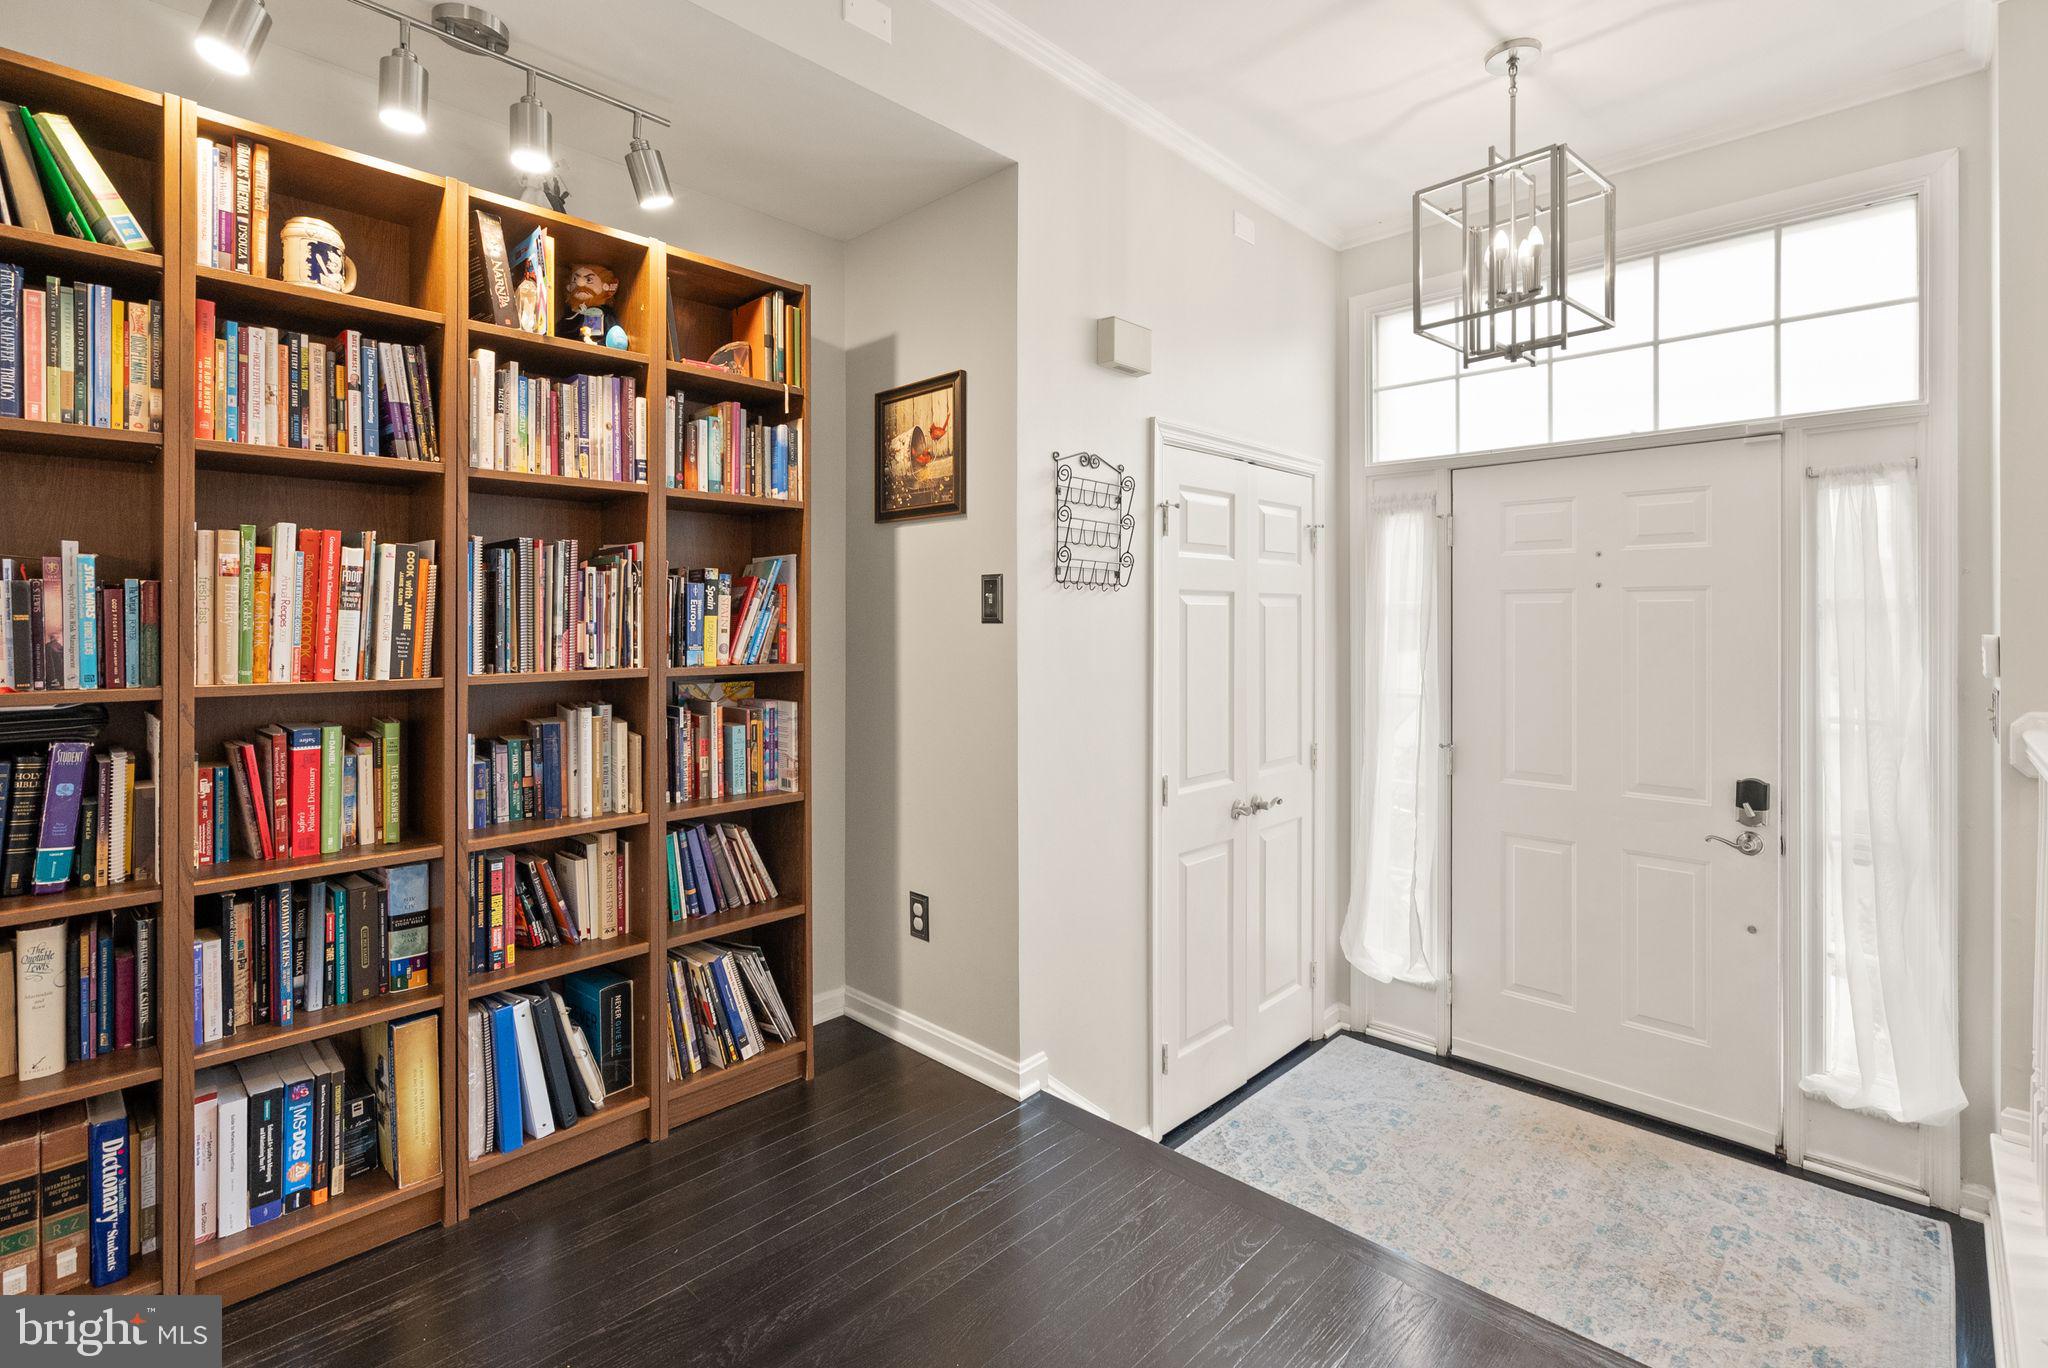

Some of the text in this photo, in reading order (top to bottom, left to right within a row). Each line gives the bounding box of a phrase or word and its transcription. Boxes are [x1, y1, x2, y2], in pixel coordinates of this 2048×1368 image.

[236, 143, 250, 259] OBAMA'S AMERICA D'SOUZA
[491, 259, 510, 308] NARNIA
[0, 270, 16, 402] FRANCIS SCHAEFFER TRILOGY
[152, 359, 160, 381] GOSPEL
[304, 554, 314, 570] Betty
[328, 536, 336, 564] Gooseberry
[406, 550, 416, 578] COOK
[68, 584, 76, 600] Supply
[84, 564, 96, 619] STAR WARS
[198, 576, 210, 624] fresh fast
[243, 566, 252, 632] Christmas Cookbook
[405, 580, 414, 599] with
[706, 584, 716, 610] Spain
[220, 583, 238, 625] Holiday
[278, 599, 290, 628] Recipes
[402, 601, 412, 630] JAMIE
[689, 599, 698, 632] Europe
[720, 596, 729, 628] SPAIN
[128, 620, 136, 640] FOSTER
[254, 591, 268, 648] Cookbook
[301, 600, 314, 658] COOKBOOK
[324, 615, 332, 634] through
[382, 614, 391, 642] FLAVOR
[68, 634, 76, 668] Management
[324, 636, 332, 644] the
[56, 750, 84, 763] STUDENT
[328, 740, 336, 766] DANIEL
[15, 772, 41, 780] HOLY
[392, 782, 398, 790] IQ
[308, 767, 318, 832] Political Dictionary
[298, 812, 310, 833] Safire's
[606, 863, 614, 893] HISTORY
[281, 888, 290, 968] UNCOMMON CURES
[297, 908, 305, 932] YOUNG
[21, 950, 54, 965] Quotable
[30, 945, 45, 955] The
[140, 929, 148, 990] THE CHRISTIAN
[26, 963, 50, 973] Lewis
[296, 952, 304, 976] SHACK
[614, 995, 622, 1018] NEVER
[258, 1134, 266, 1158] Maintaining
[292, 1108, 307, 1160] MS-DOS
[295, 1165, 306, 1177] 20
[48, 1182, 81, 1196] DICTIONARY
[64, 1194, 79, 1202] BIBLE
[12, 1210, 29, 1218] BIBLE
[95, 1136, 125, 1272] Dictionary Students
